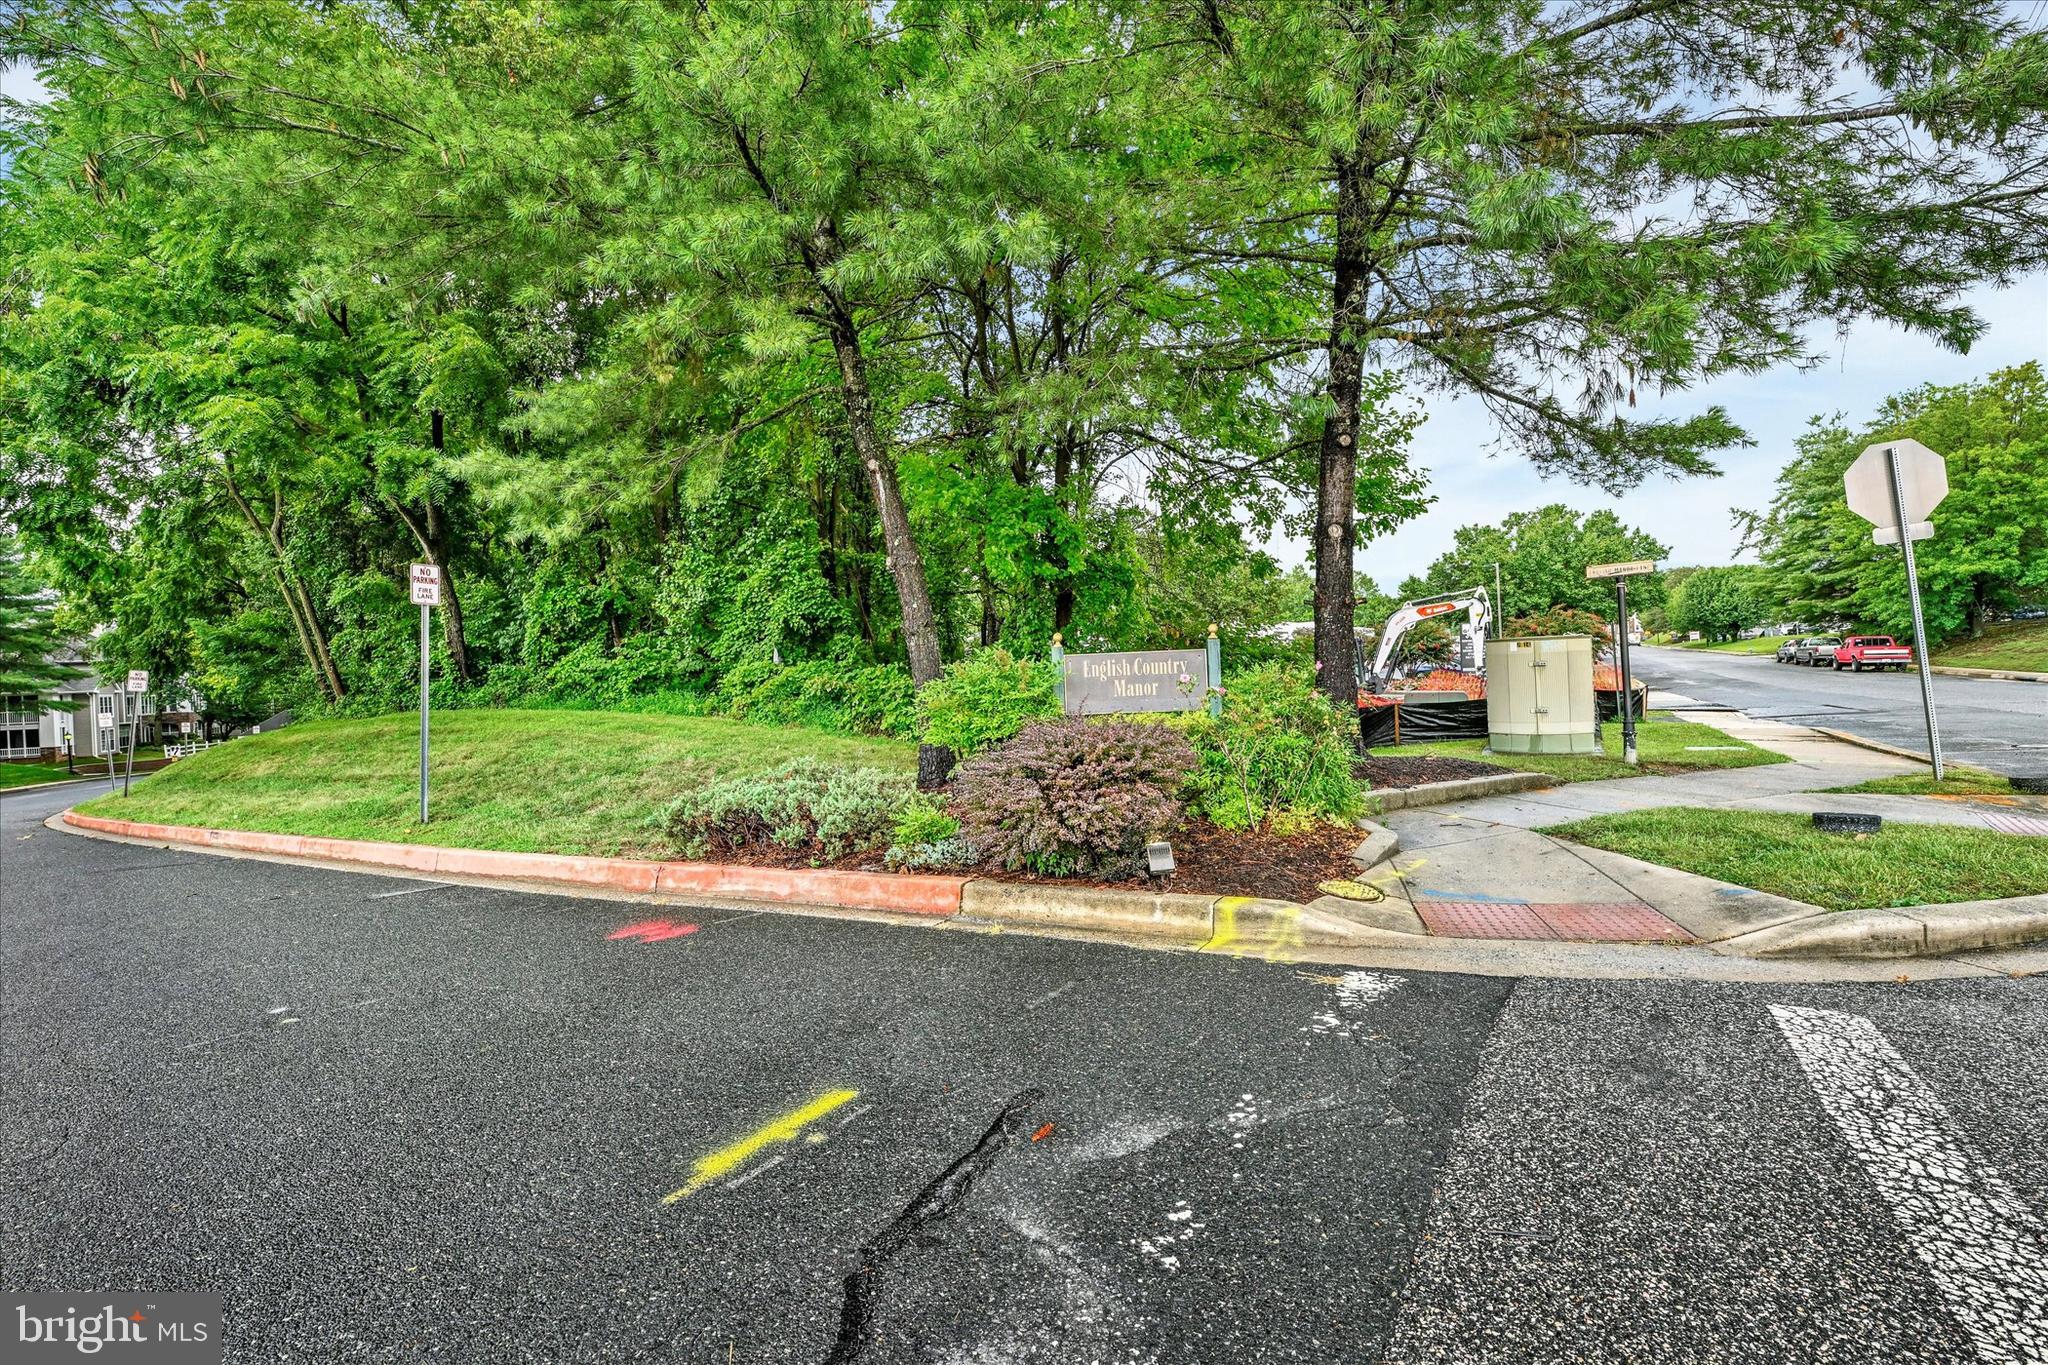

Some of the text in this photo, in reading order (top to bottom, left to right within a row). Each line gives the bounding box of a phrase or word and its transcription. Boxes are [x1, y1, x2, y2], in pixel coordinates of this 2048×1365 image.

[420, 568, 431, 577] NO
[413, 576, 438, 585] PARKING
[1083, 657, 1188, 681] English Country
[1114, 679, 1159, 697] Manor
